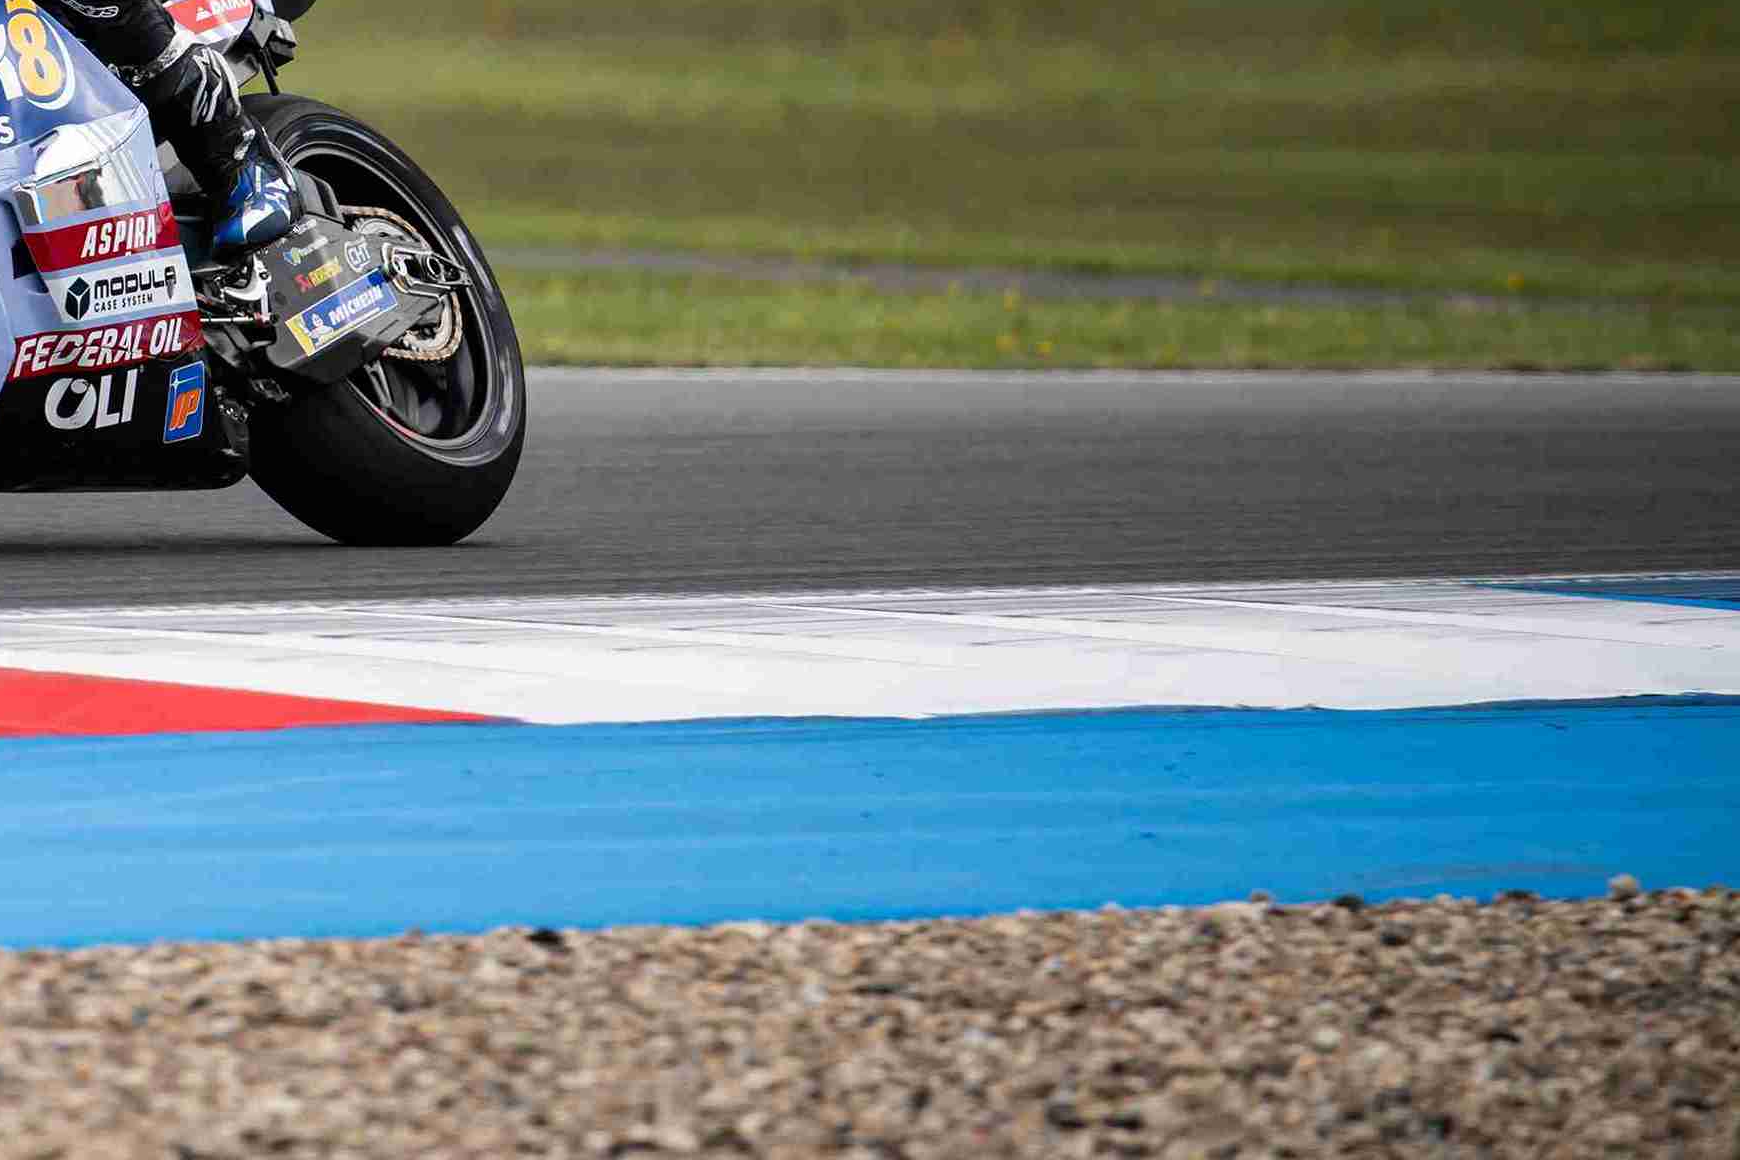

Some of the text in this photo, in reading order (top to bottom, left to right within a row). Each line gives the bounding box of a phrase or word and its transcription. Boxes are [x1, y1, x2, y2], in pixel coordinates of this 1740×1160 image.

[80, 213, 156, 259] ASPIRA
[94, 265, 177, 300] MODULA
[94, 293, 154, 313] CASE SYSTEM
[13, 316, 183, 378] FEDERAL OIL
